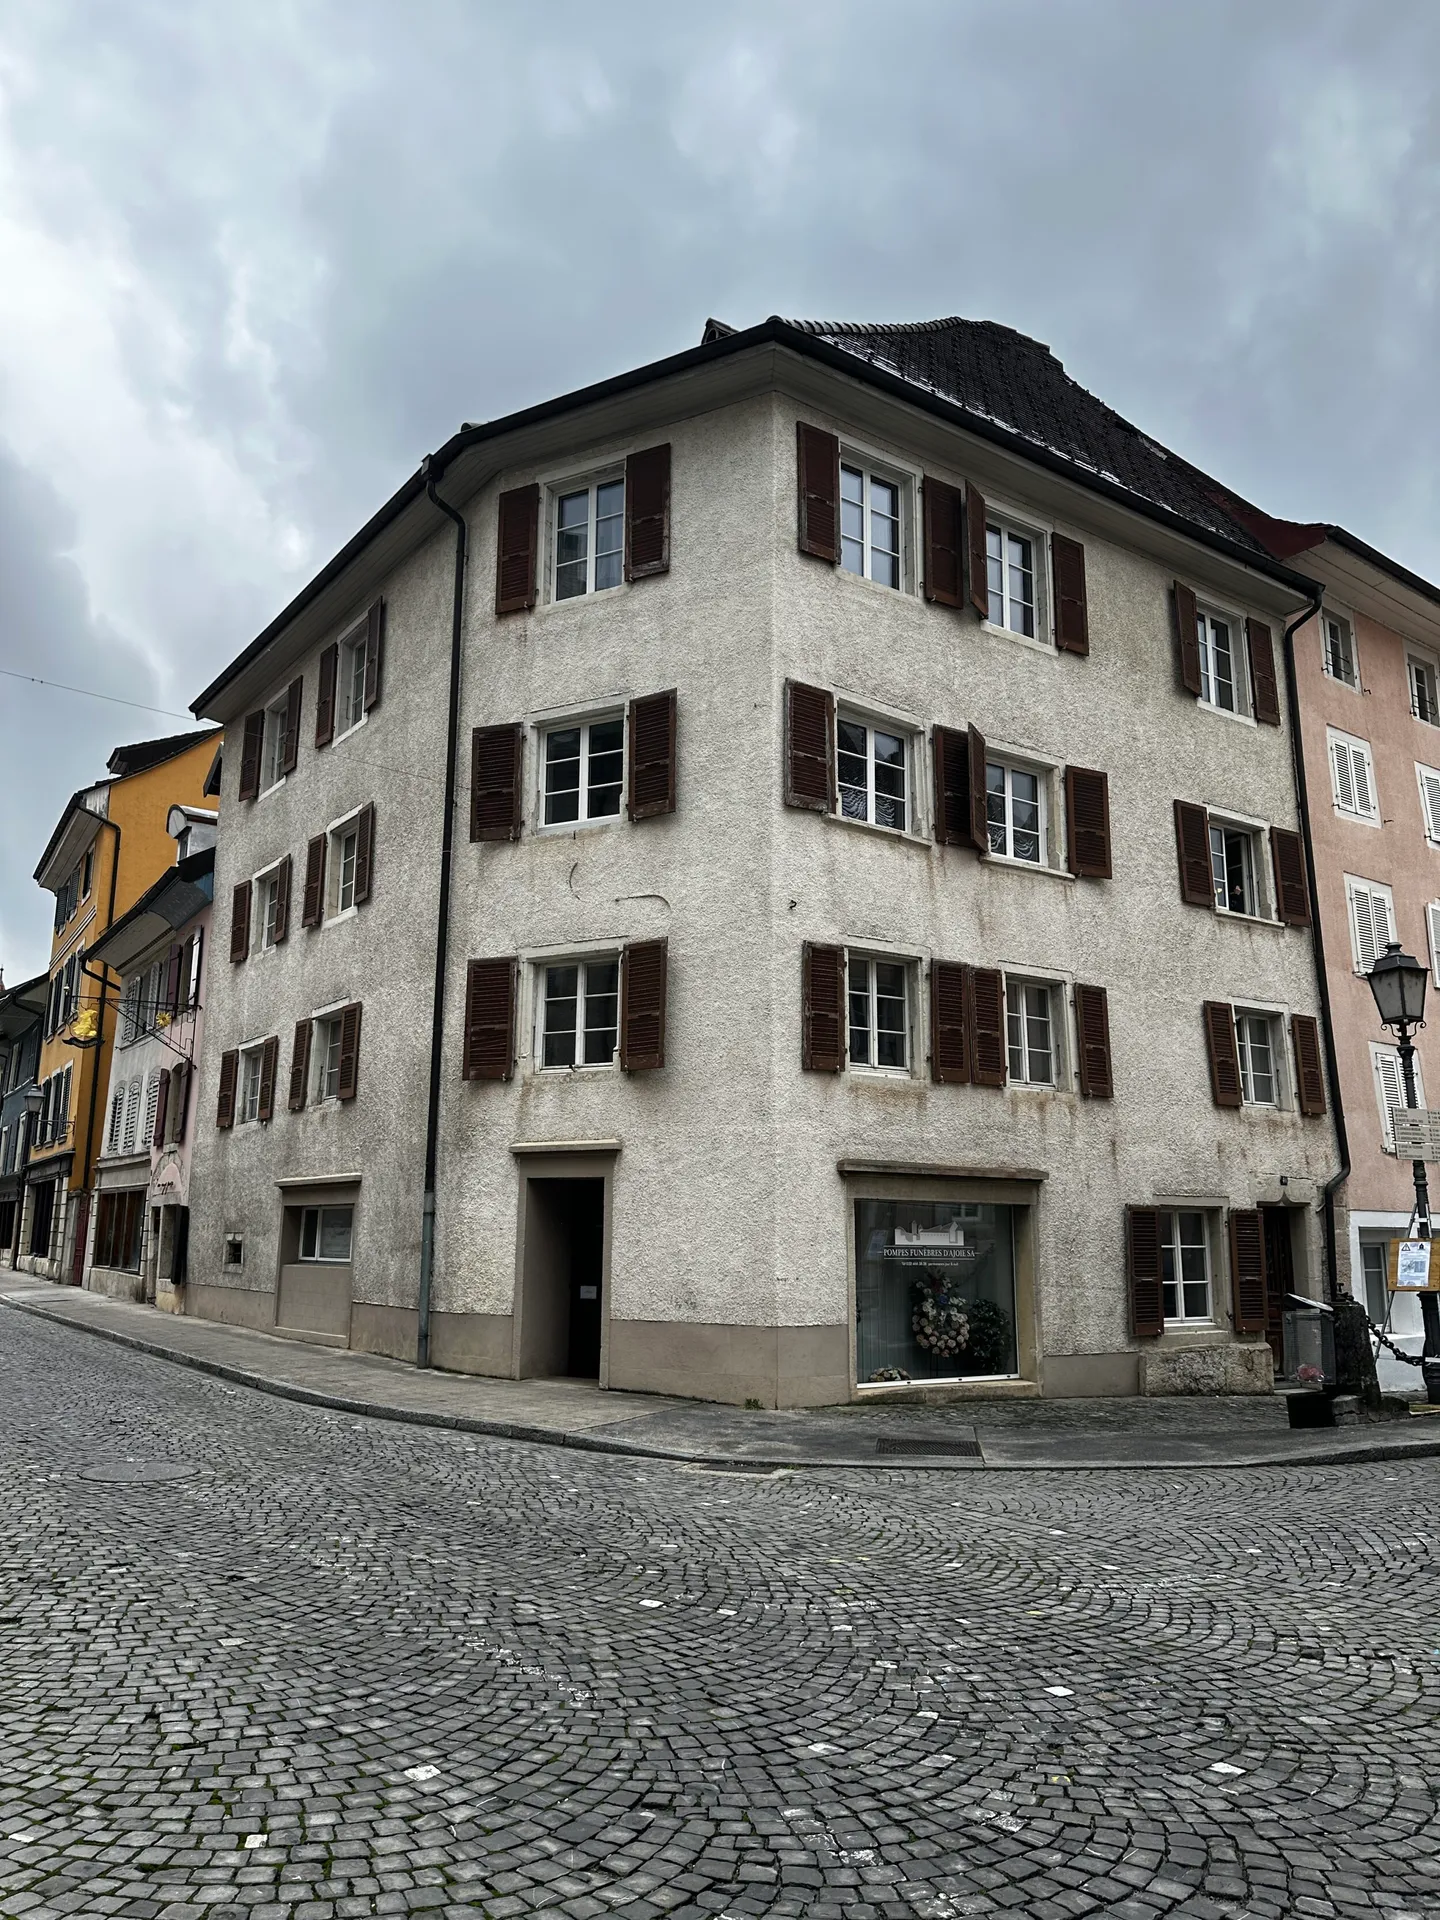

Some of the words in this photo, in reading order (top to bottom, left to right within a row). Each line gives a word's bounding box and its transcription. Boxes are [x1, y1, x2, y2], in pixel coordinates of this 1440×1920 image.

[883, 1248, 909, 1257] POMPES
[910, 1247, 942, 1257] FUNÈBRES
[943, 1249, 966, 1258] D'AJOIE
